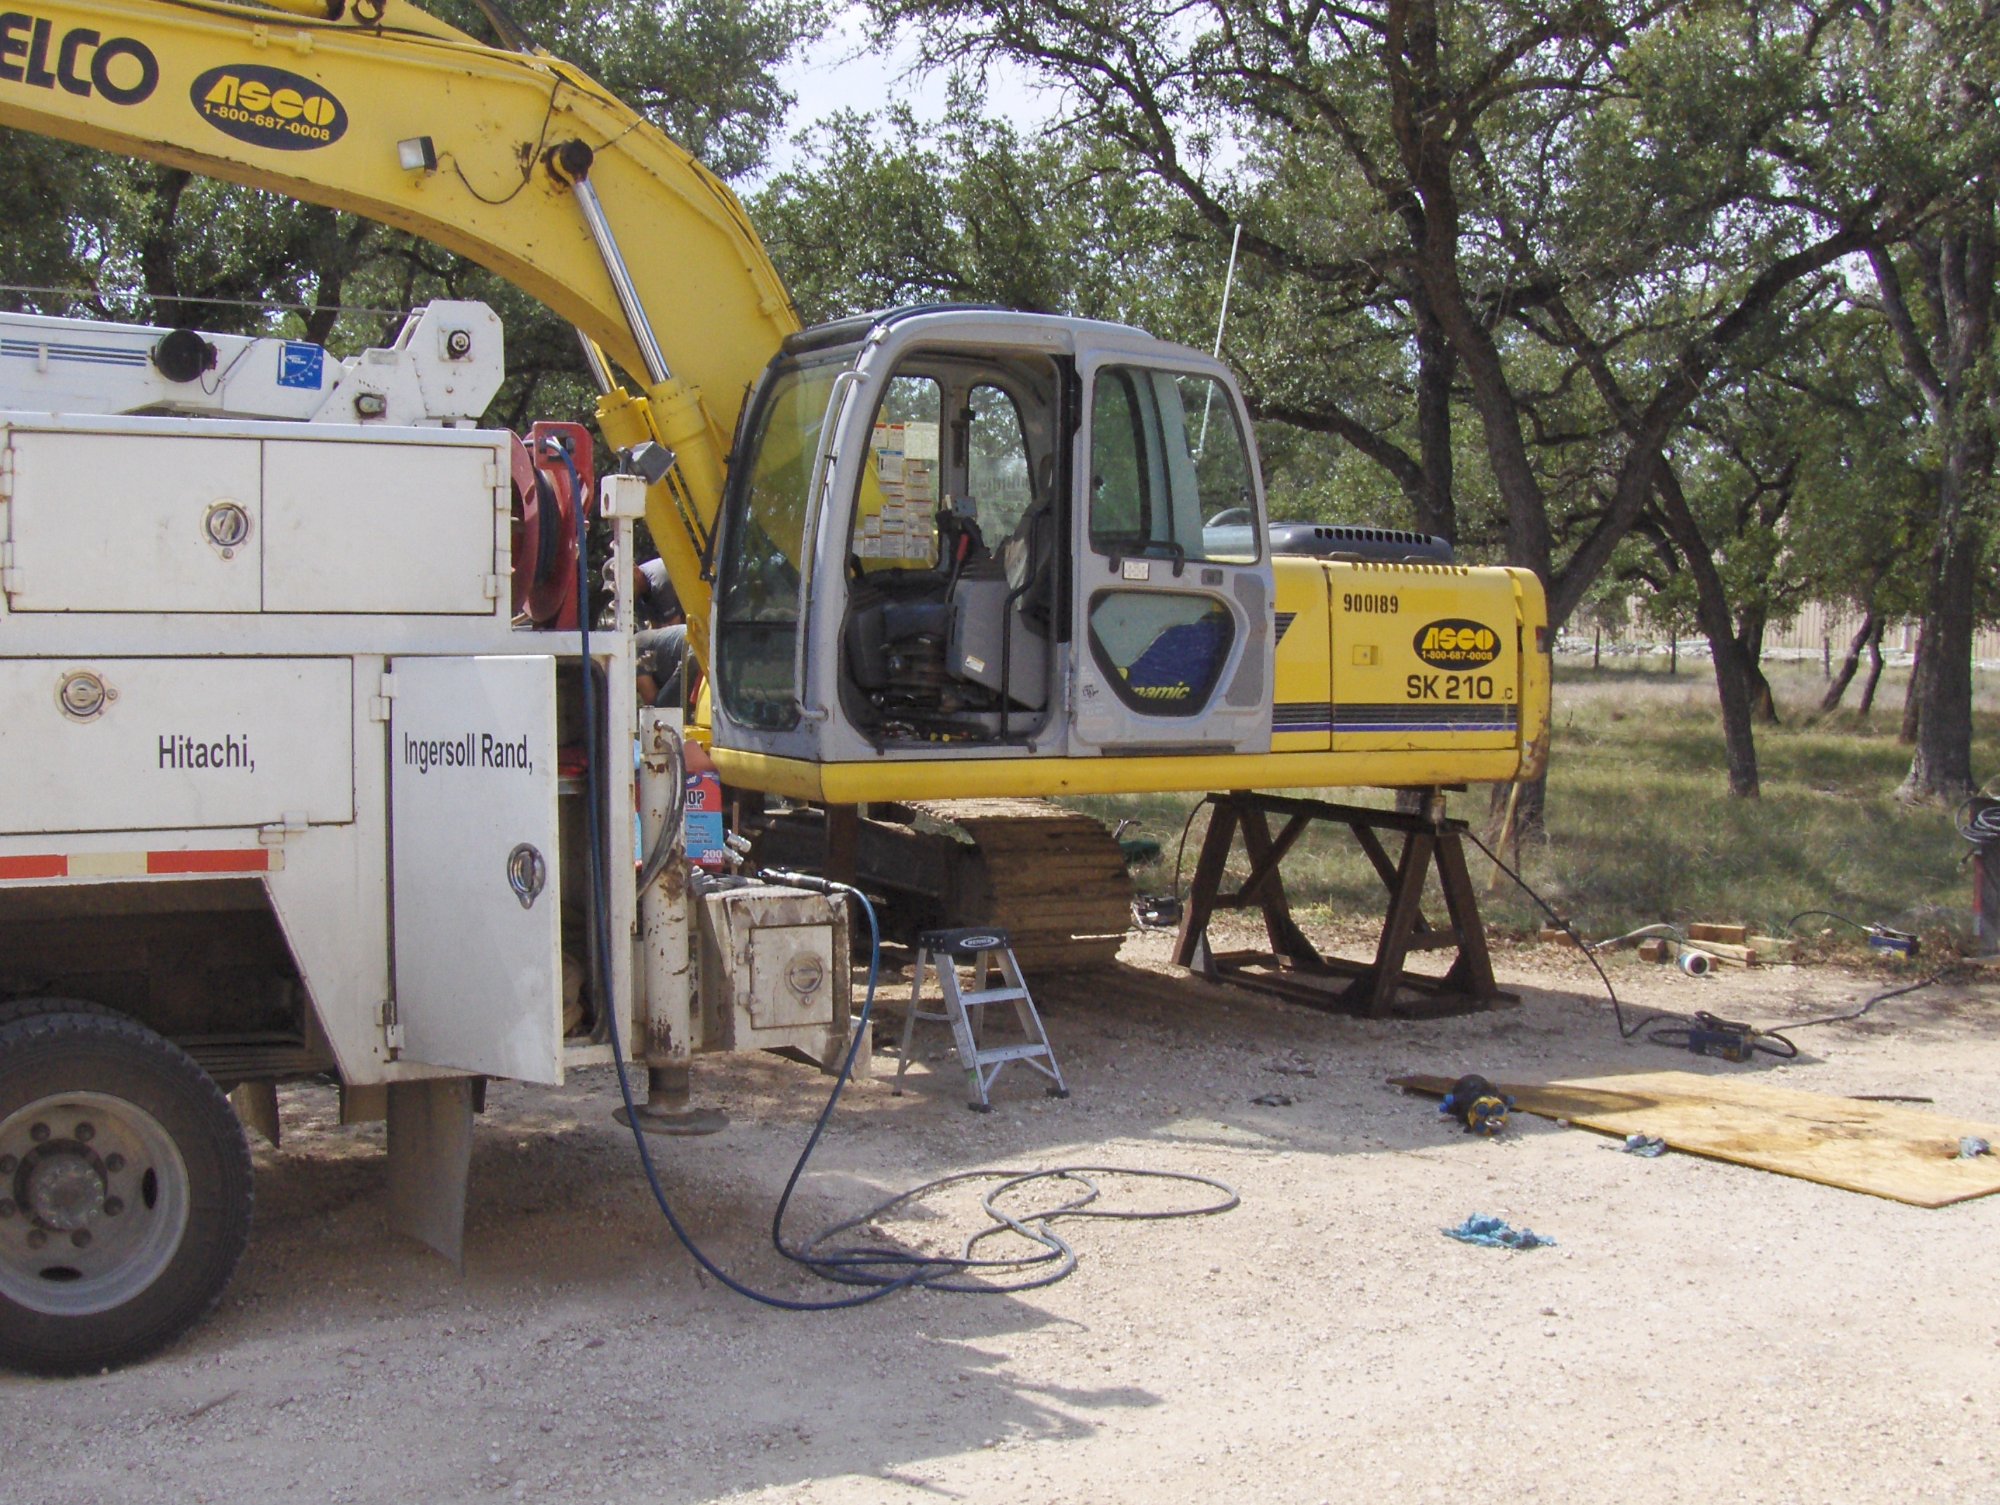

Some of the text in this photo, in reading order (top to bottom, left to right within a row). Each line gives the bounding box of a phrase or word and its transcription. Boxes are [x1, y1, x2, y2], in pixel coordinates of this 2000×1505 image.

[204, 74, 336, 126] ASCO
[203, 103, 330, 141] 1-800-687-0008
[1343, 593, 1398, 613] 900189
[1421, 627, 1494, 650] ASCO
[1422, 651, 1493, 661] 1-800-687-0008
[1131, 681, 1190, 699] namic
[1407, 674, 1439, 699] SK
[1446, 676, 1493, 699] 210
[158, 734, 255, 773] Hitachi,
[404, 732, 533, 774] Ingersoll Rand,
[686, 790, 705, 805] OP
[703, 850, 722, 858] 200
